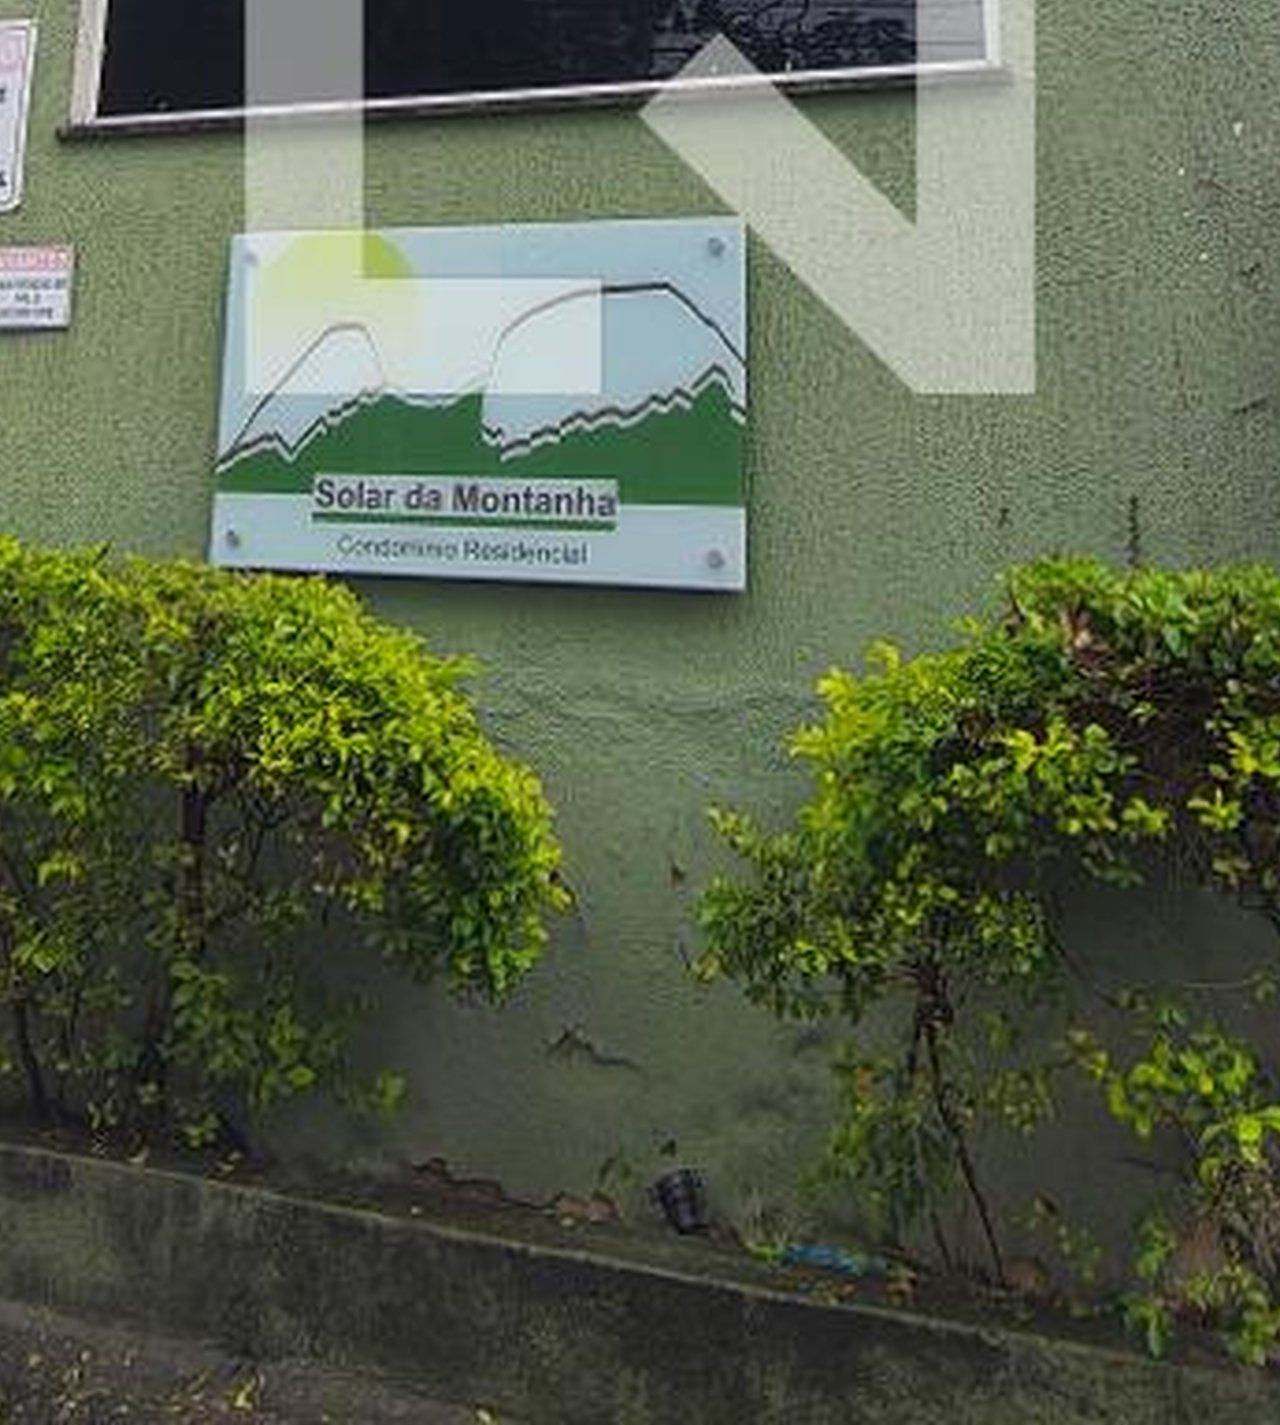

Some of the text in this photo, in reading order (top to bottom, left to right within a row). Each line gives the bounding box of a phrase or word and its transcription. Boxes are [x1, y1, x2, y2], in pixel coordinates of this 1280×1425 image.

[314, 480, 617, 518] Solar da Montanha
[464, 539, 588, 565] Residencial
